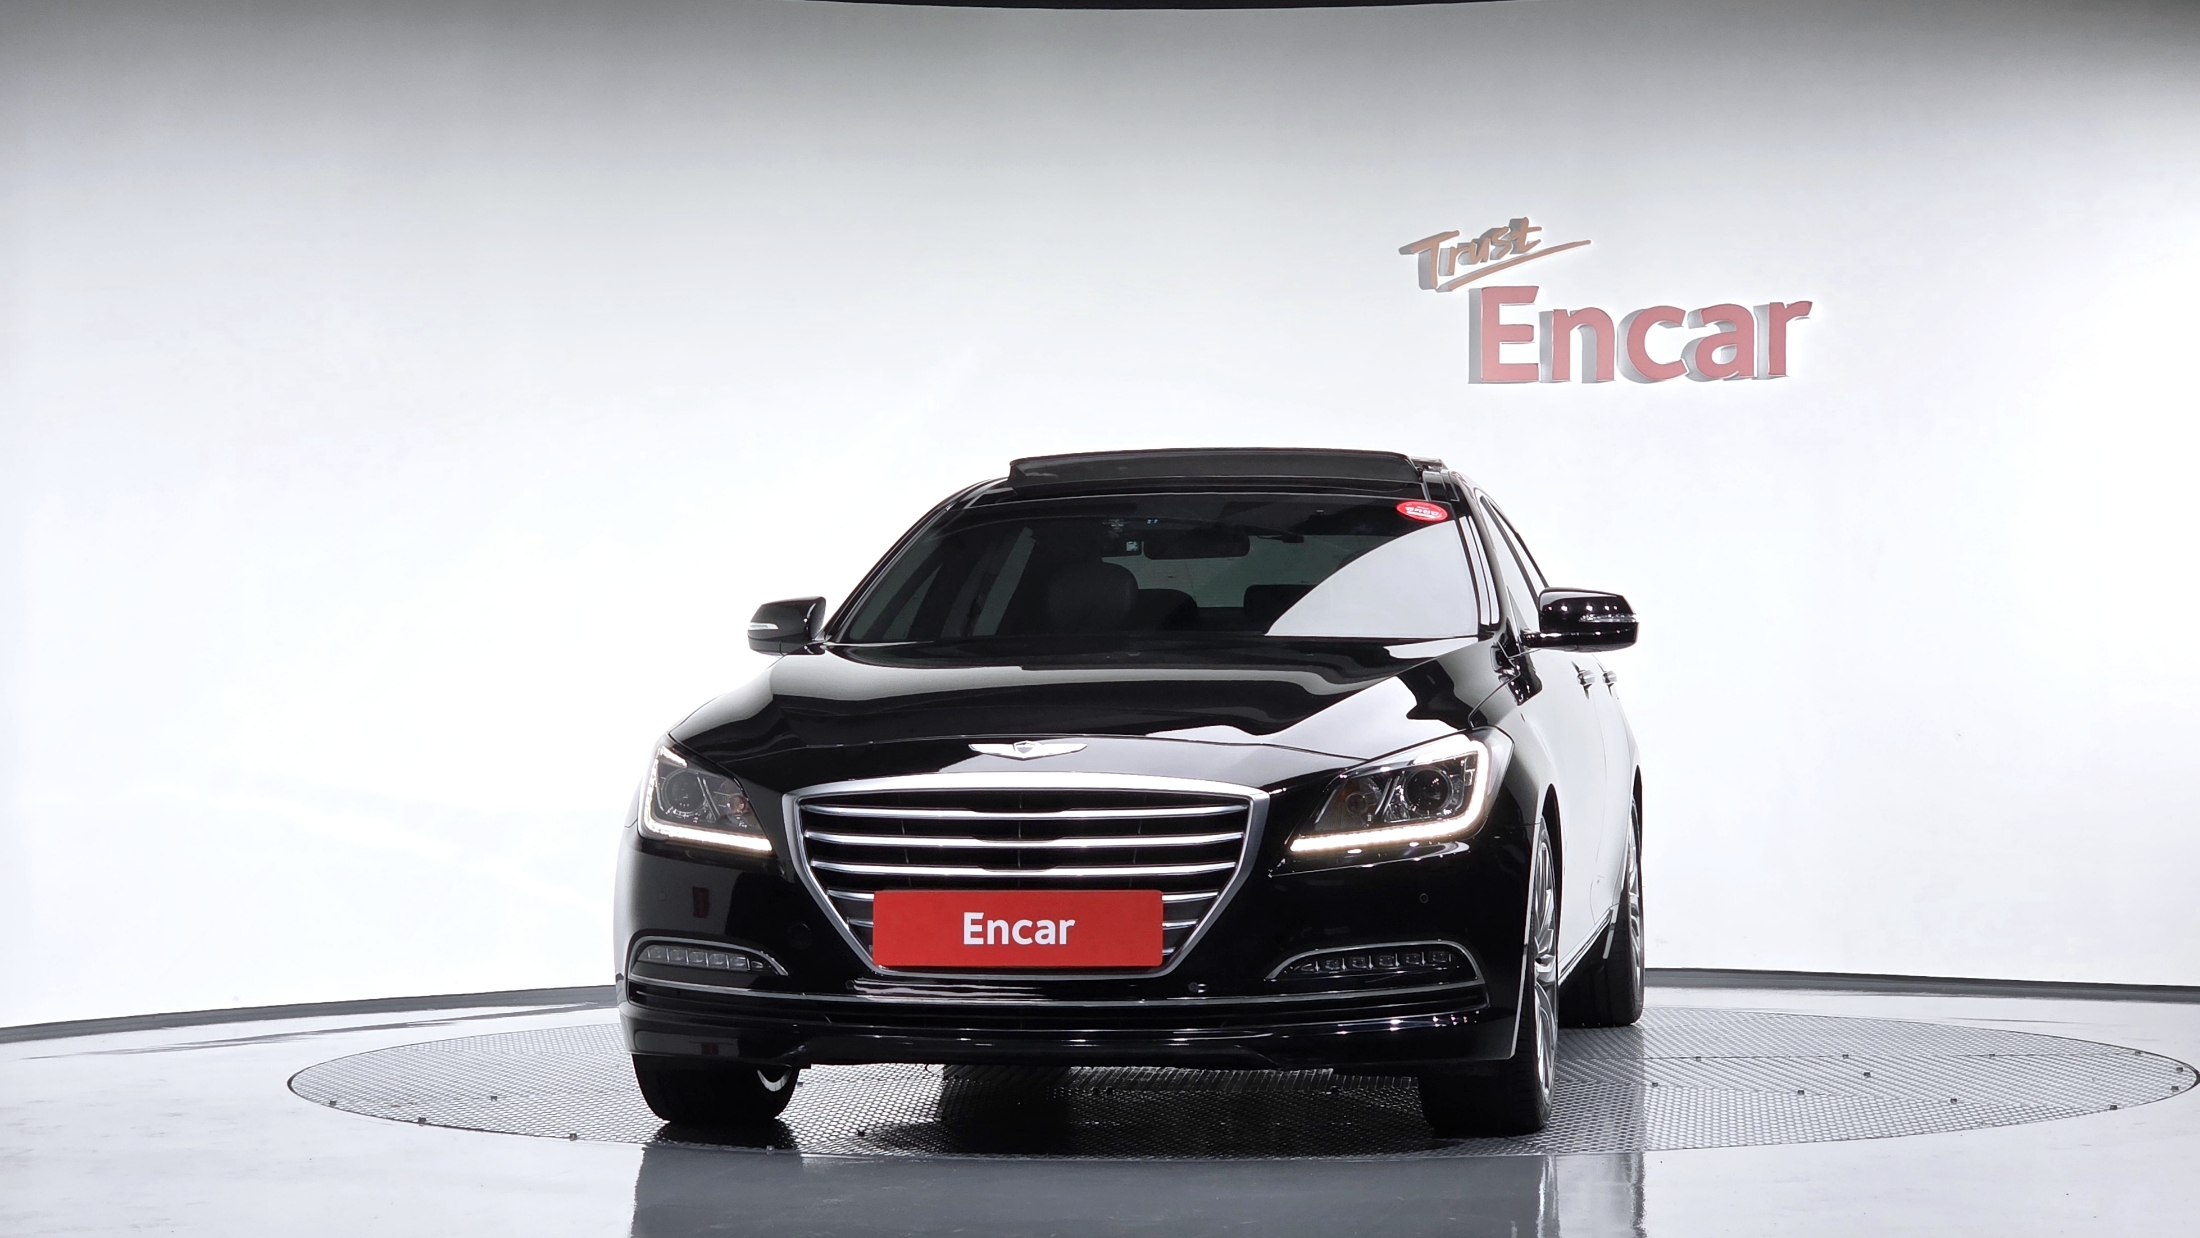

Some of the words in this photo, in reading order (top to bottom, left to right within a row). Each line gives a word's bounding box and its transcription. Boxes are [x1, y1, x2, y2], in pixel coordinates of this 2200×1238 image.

[1399, 216, 1546, 291] Trust
[1470, 285, 1813, 383] Encar
[963, 911, 1076, 945] Encar
